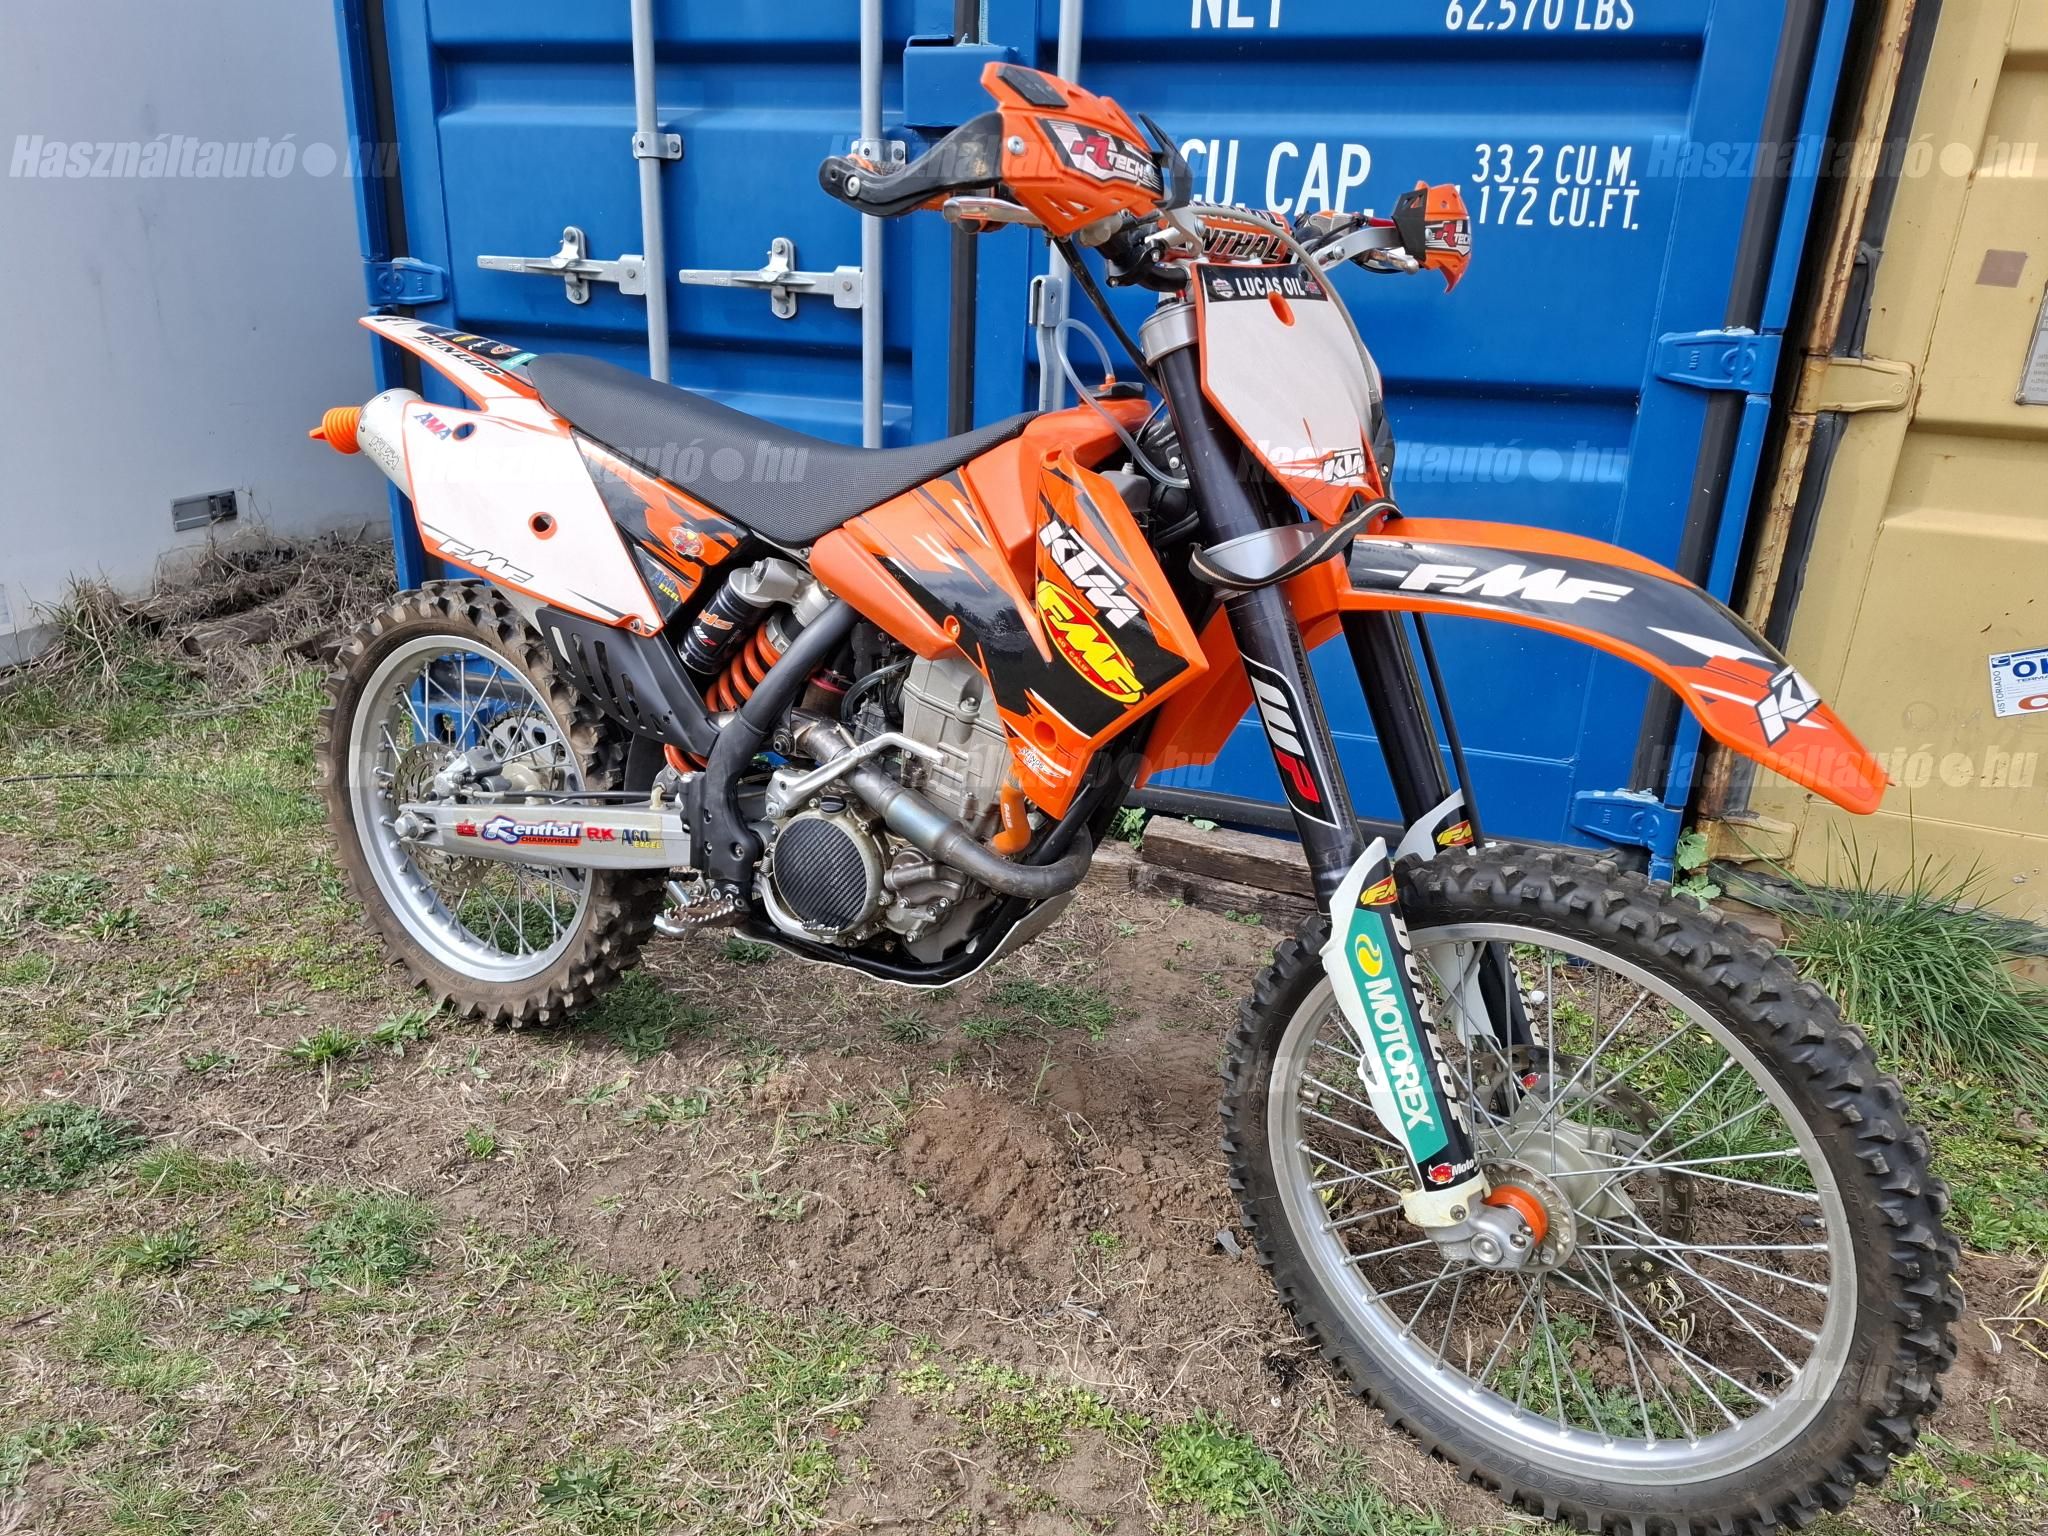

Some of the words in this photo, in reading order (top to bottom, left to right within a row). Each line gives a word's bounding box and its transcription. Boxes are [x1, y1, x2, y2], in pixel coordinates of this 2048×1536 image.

[1575, 0, 1634, 30] LBS
[1265, 141, 1374, 217] CAP.
[1472, 144, 1544, 184] 33.2
[1555, 145, 1637, 187] CU.M.
[1549, 187, 1640, 230] CU.FT.
[1201, 227, 1283, 262] NTHAL
[1235, 276, 1281, 296] LUCAS
[1282, 277, 1306, 296] OIL
[414, 335, 501, 375] DUNLOP
[413, 412, 452, 441] AMA
[437, 539, 534, 584] FMF
[1039, 520, 1139, 629] KTM
[1399, 564, 1634, 604] FMF
[1038, 585, 1144, 693] FMF
[1993, 670, 2006, 714] VISTORIADO
[586, 827, 616, 841] RK
[1364, 976, 1433, 1132] MOTOREX
